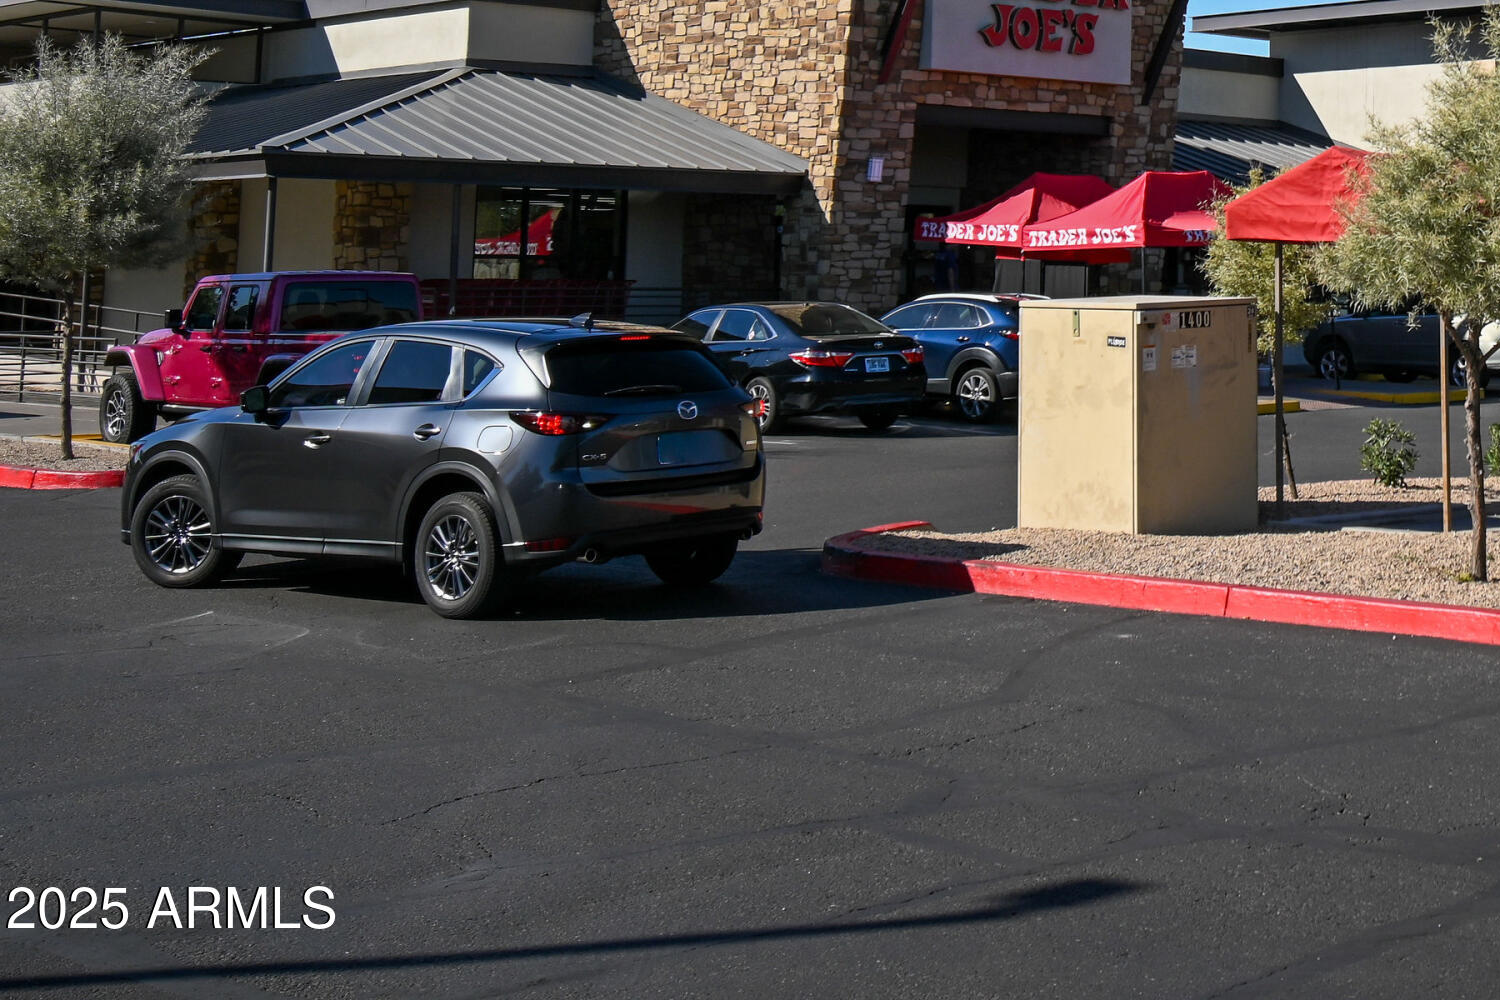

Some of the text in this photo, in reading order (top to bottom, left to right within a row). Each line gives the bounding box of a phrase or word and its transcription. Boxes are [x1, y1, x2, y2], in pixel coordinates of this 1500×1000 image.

[978, 4, 1100, 55] JOE'S
[921, 221, 1019, 242] TRADER JOE'S
[1028, 225, 1137, 246] TRADER JOE'S
[1180, 311, 1210, 328] 1400
